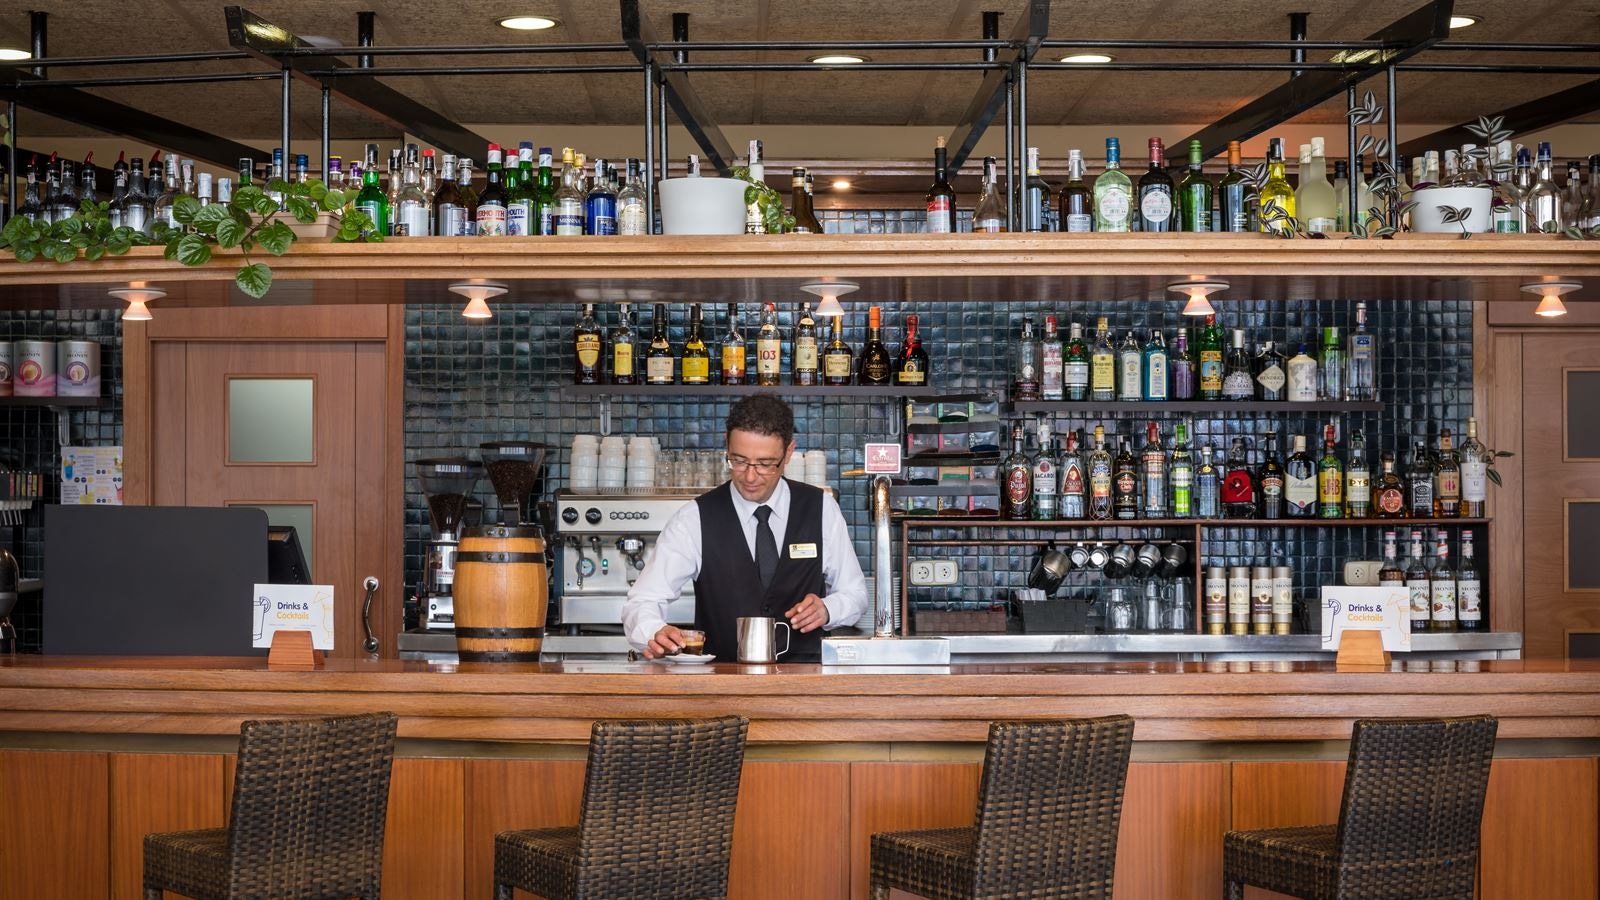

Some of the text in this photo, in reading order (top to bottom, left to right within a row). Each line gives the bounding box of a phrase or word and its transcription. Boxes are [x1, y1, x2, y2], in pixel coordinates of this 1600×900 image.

[759, 350, 776, 361] 103
[277, 602, 309, 611] Drinks &
[1348, 604, 1383, 613] Drinks &
[276, 612, 310, 620] Cocktails
[1347, 613, 1384, 622] Cocktails
